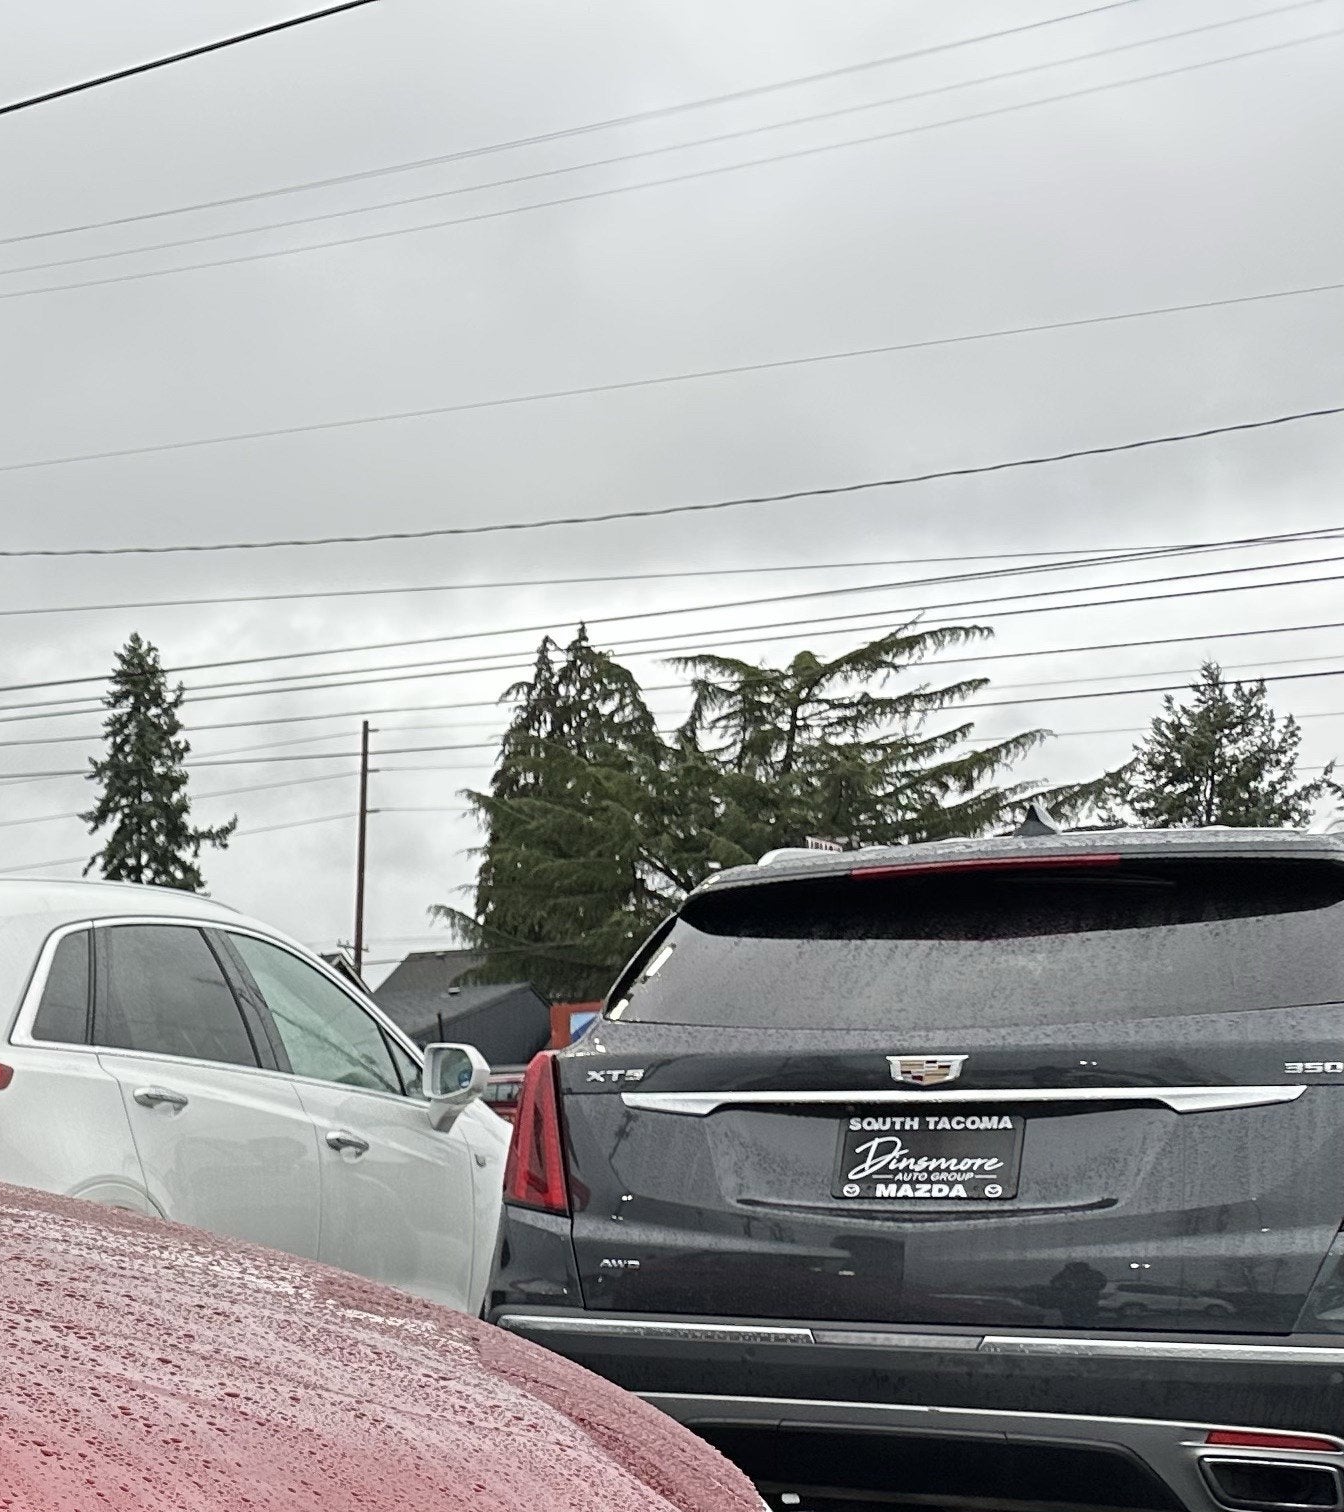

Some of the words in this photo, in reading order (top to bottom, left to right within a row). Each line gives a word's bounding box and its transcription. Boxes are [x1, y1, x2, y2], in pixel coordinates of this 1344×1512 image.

[1284, 1062, 1343, 1073] 350
[849, 1116, 920, 1131] SOUTH
[925, 1115, 1014, 1131] TACOMA
[848, 1136, 1005, 1180] Dinsmore
[894, 1172, 928, 1182] AUTO
[930, 1171, 975, 1182] GROUP
[875, 1184, 968, 1198] MAZDA
